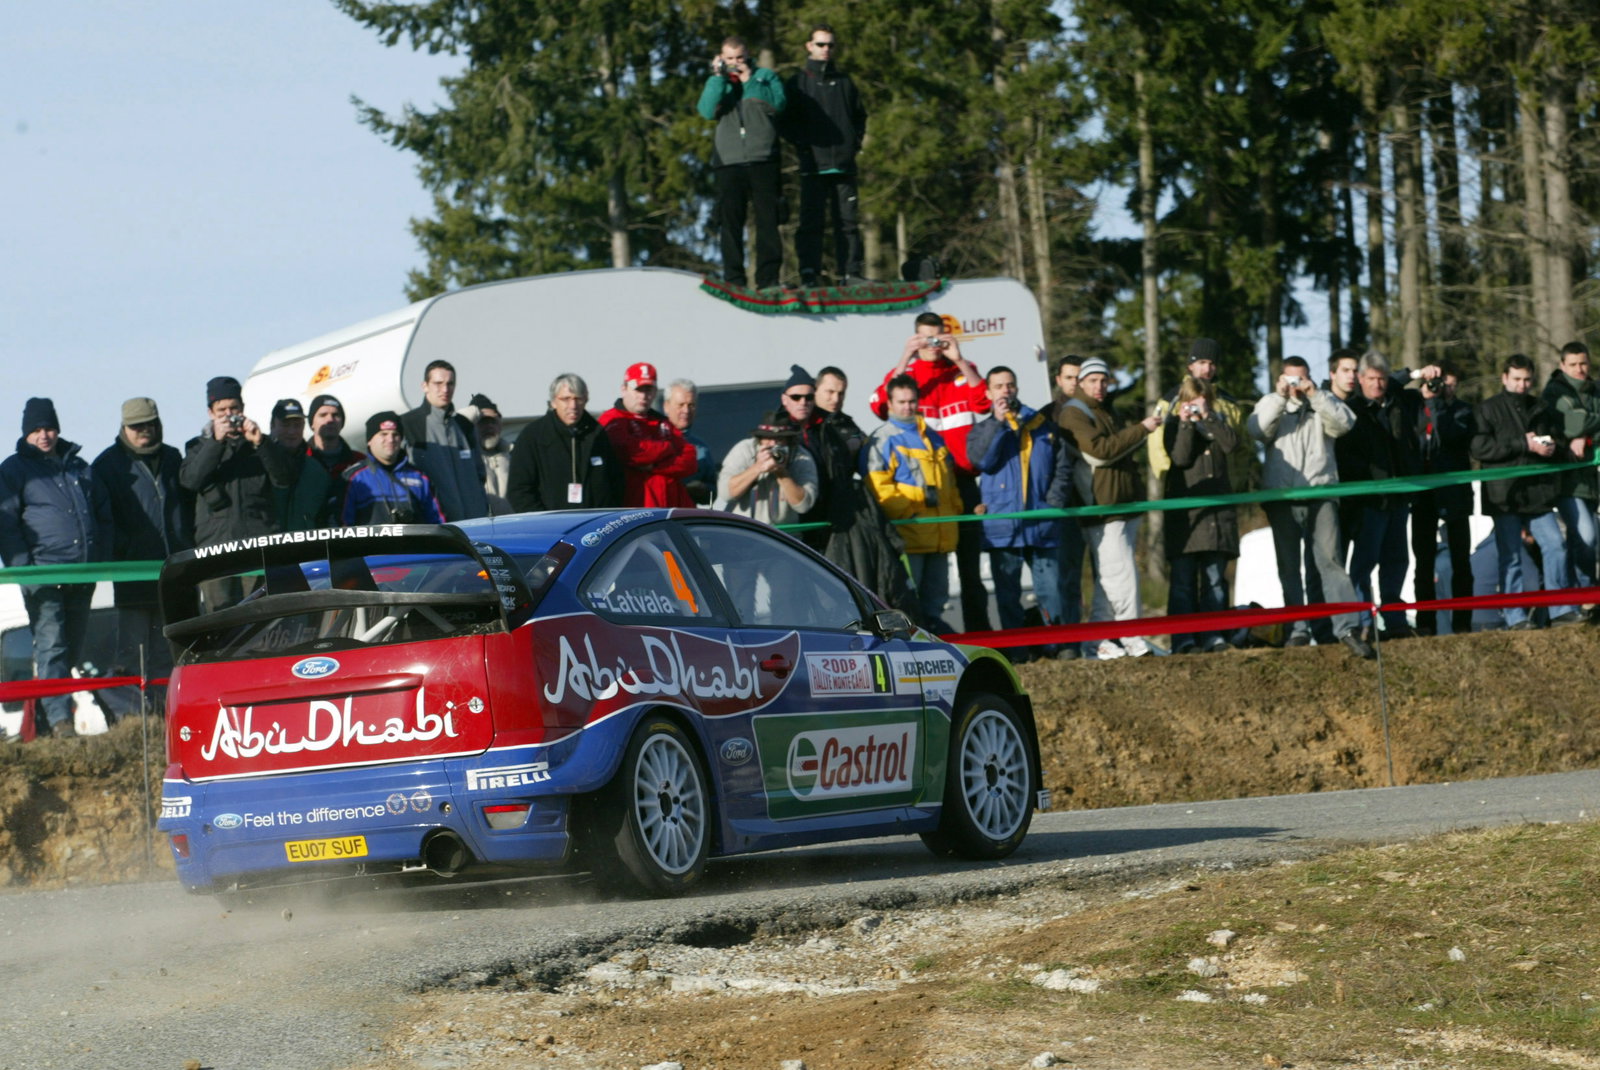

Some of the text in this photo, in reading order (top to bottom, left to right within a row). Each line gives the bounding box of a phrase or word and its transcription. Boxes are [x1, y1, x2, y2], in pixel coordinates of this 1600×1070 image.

[194, 525, 404, 559] WWW.VISITABUDHABI.AE
[663, 551, 699, 614] 4
[604, 590, 675, 614] Latvala
[811, 664, 833, 691] RALLYE
[821, 658, 857, 675] 2008
[875, 654, 886, 693] 4
[820, 730, 909, 791] Castrol
[466, 761, 552, 791] PIRELLI
[244, 812, 275, 828] Feel
[277, 810, 303, 825] the
[306, 804, 386, 824] difference
[289, 838, 363, 859] EU07 SUF
